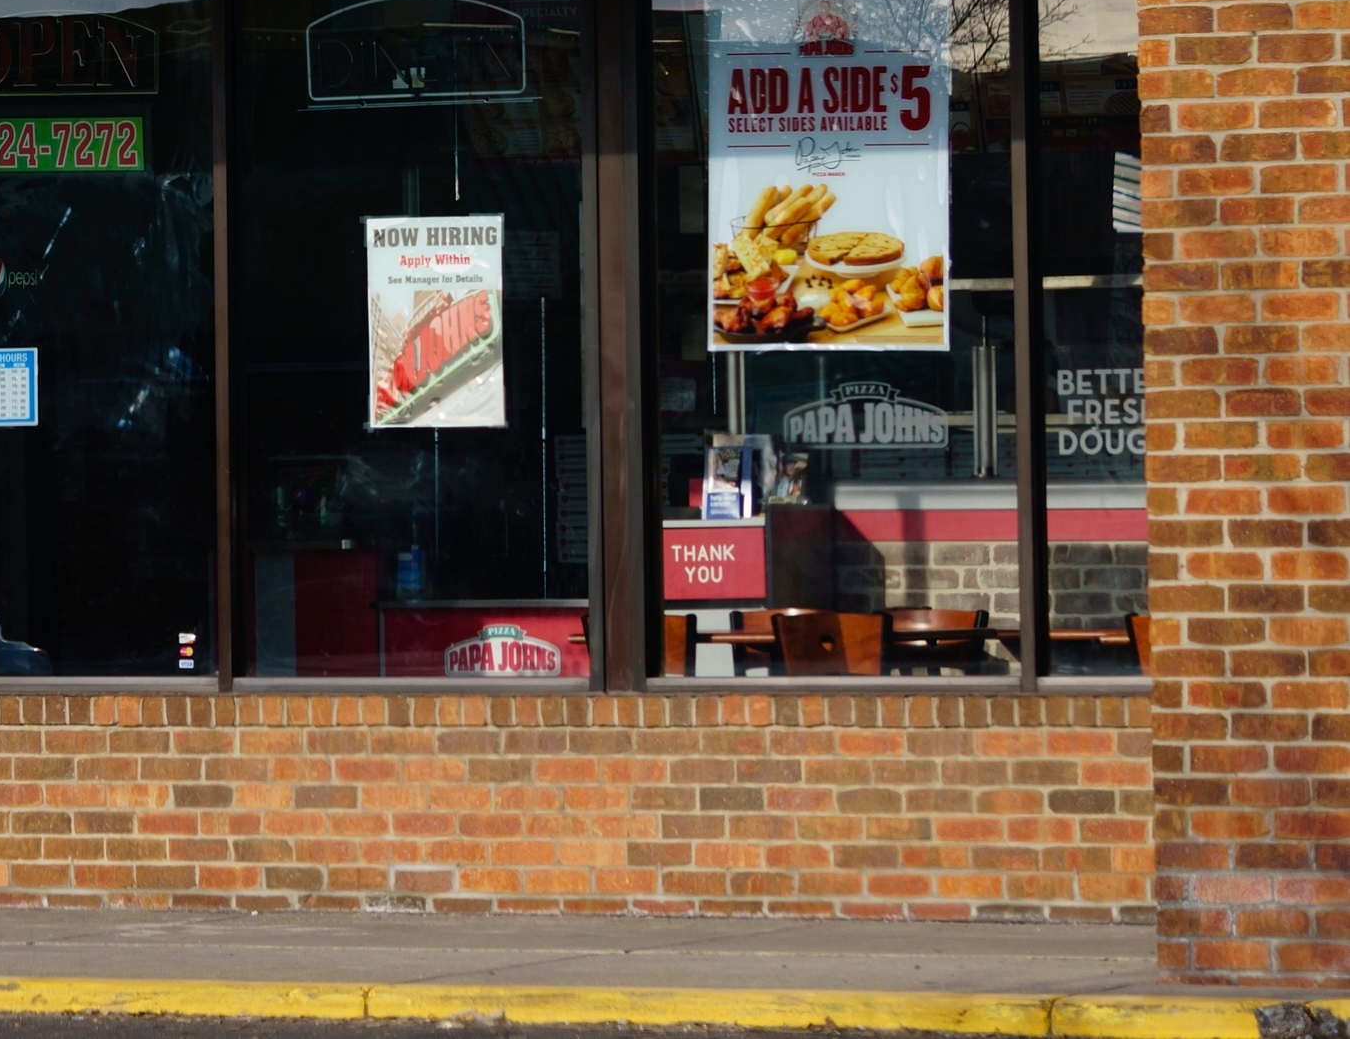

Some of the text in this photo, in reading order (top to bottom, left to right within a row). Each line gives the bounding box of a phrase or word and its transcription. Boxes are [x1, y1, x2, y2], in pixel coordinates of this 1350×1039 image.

[317, 38, 436, 89] DINE
[727, 68, 789, 115] ADD
[797, 67, 816, 114] A
[822, 66, 888, 113] SIDE
[728, 115, 888, 133] SELECT SIDES AVAILABLE
[373, 226, 497, 248] NOW HIRING
[399, 253, 471, 268] Apply Within
[8, 269, 38, 289] pepsi
[388, 274, 483, 286] See Manager for Details
[0, 352, 28, 363] HOURS
[844, 384, 886, 396] PIZZA
[1056, 367, 1146, 396] BETTE
[789, 403, 856, 444] PAPA
[1057, 427, 1147, 456] DOUG
[670, 543, 736, 562] THANK
[684, 565, 724, 584] YOU
[487, 627, 517, 637] PIZZA
[448, 642, 495, 672] PAPA
